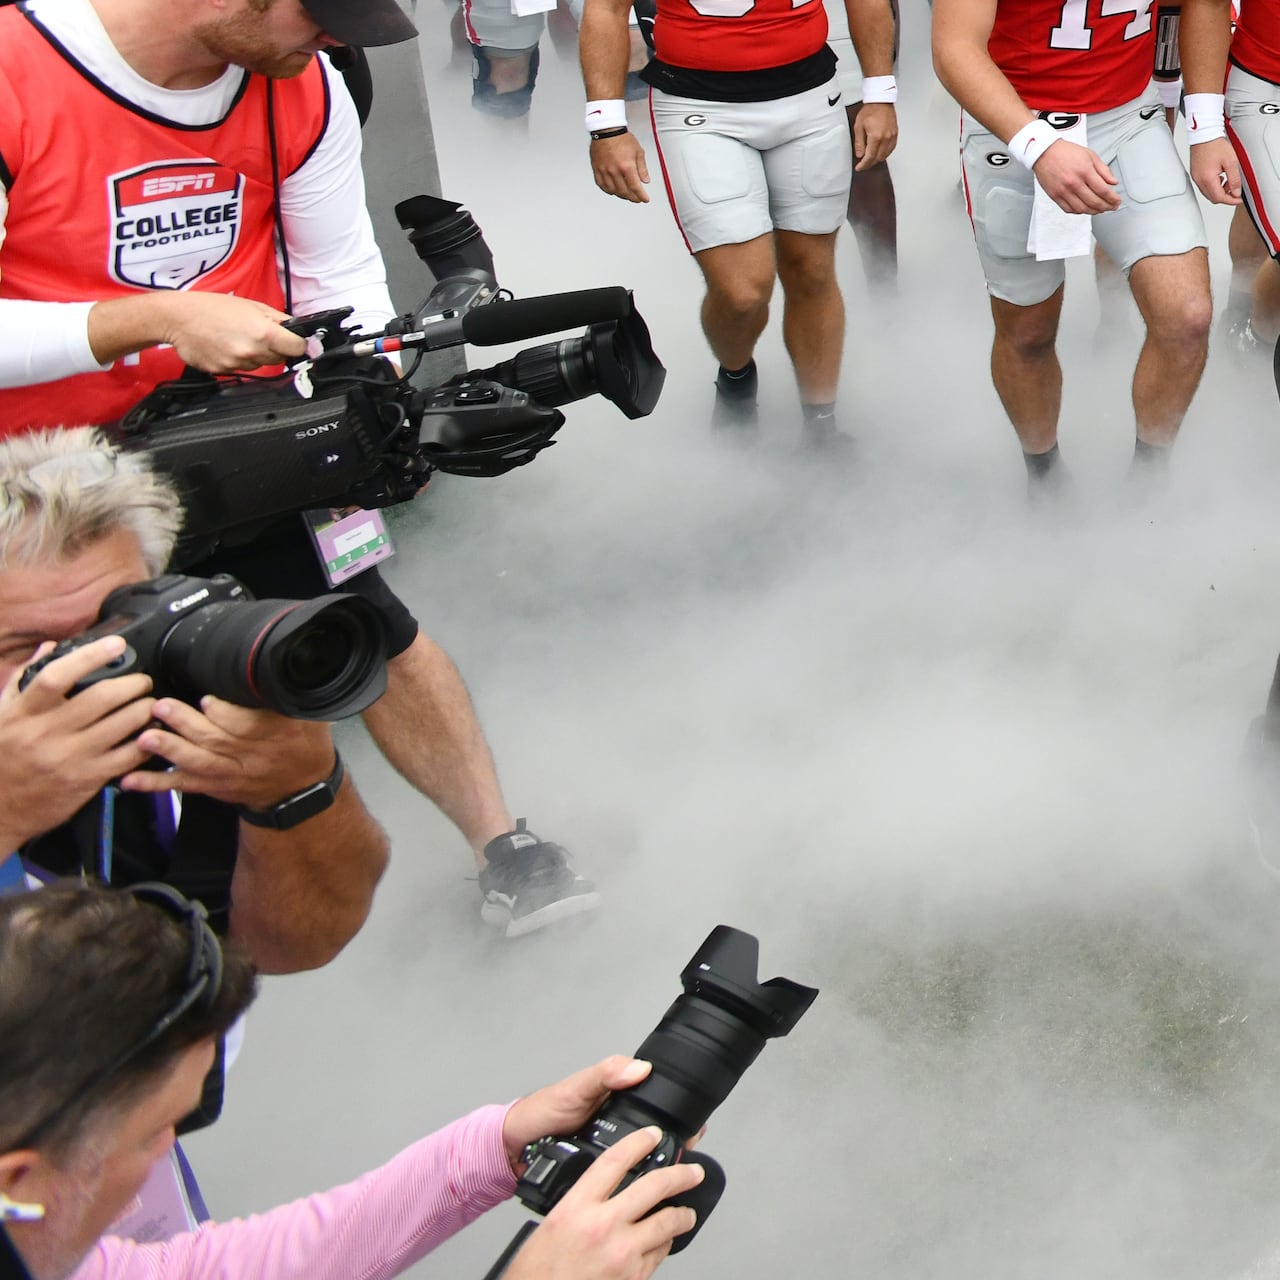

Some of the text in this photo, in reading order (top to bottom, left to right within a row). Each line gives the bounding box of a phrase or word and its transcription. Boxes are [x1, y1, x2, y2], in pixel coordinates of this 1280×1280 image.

[684, 114, 707, 126] G
[1259, 103, 1280, 115] G
[988, 152, 1010, 166] G
[143, 173, 215, 197] ESPN
[116, 202, 238, 240] COLLEGE
[131, 226, 226, 250] FOOTBALL
[295, 420, 340, 440] SONY
[345, 554, 353, 562] 2
[362, 545, 369, 554] 3
[378, 537, 385, 545] 4
[170, 587, 210, 612] Canon
